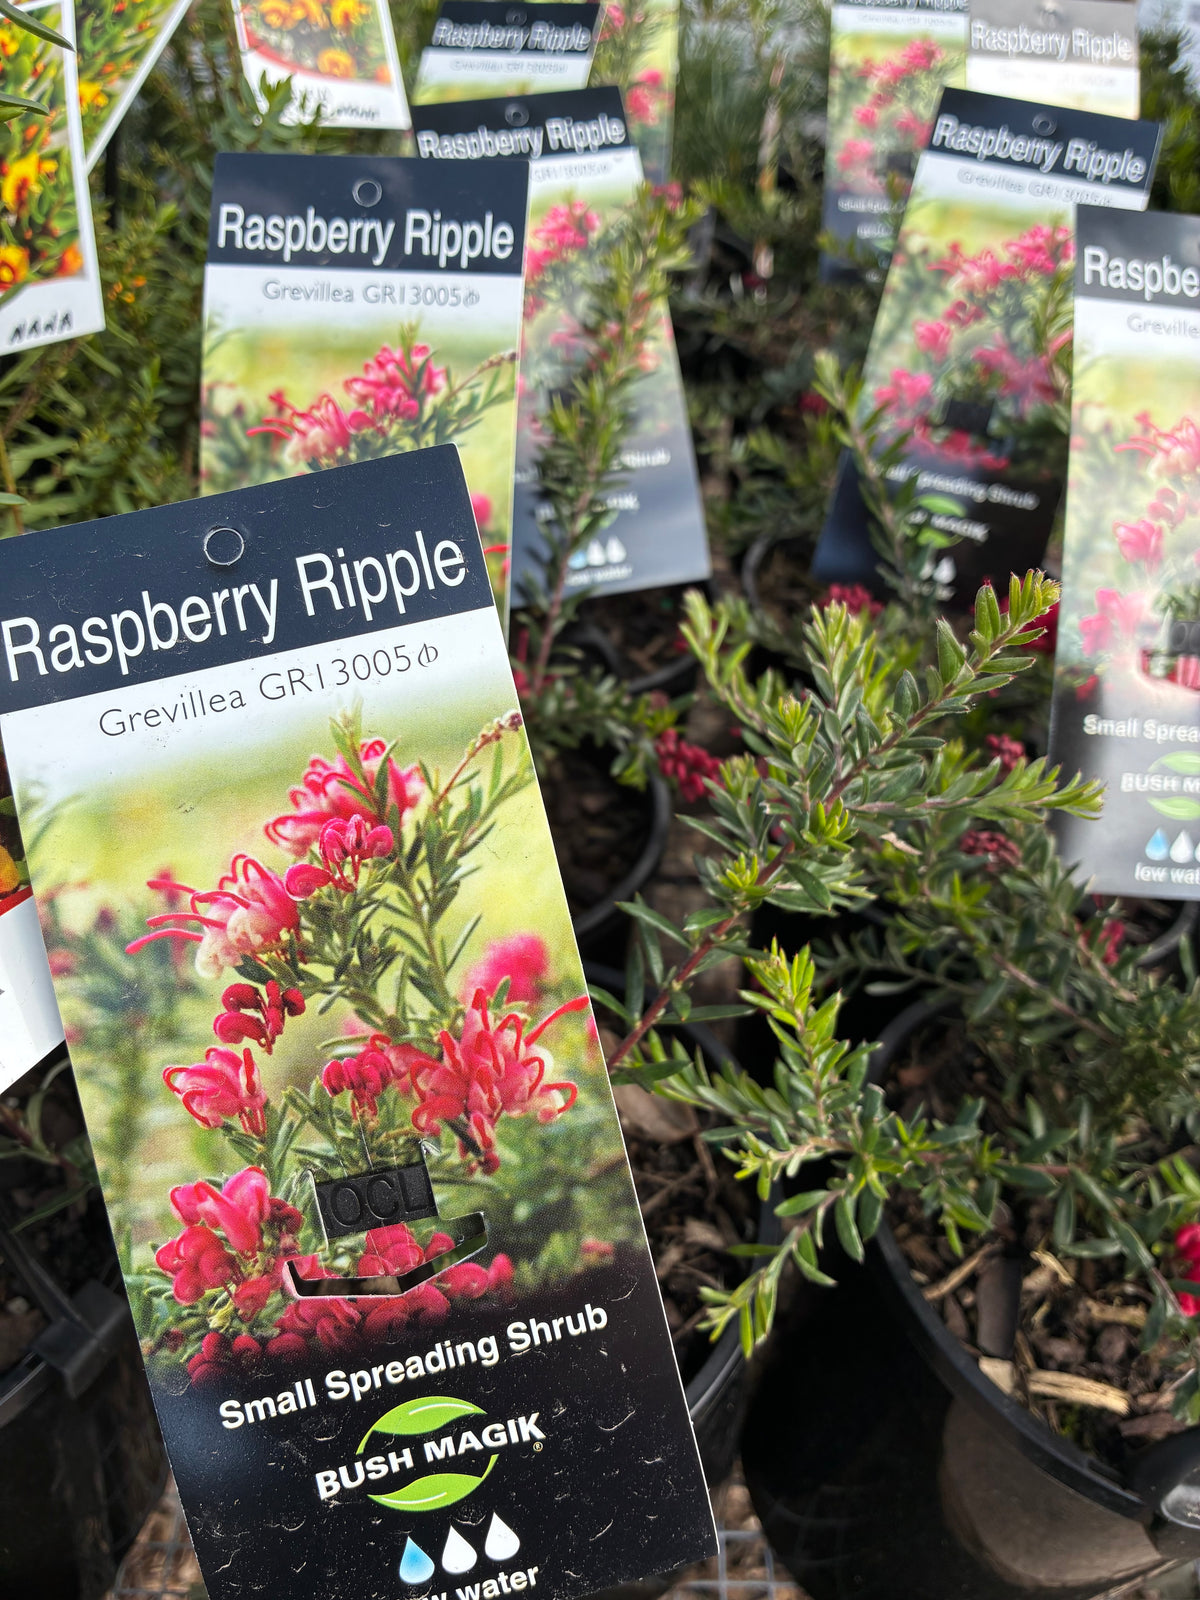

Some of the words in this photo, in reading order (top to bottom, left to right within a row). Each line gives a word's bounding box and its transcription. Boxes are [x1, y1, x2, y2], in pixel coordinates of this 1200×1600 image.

[971, 19, 1069, 62] Raspberry
[1071, 27, 1134, 64] Ripple
[416, 124, 543, 159] Raspberry
[545, 112, 626, 154] Ripple
[932, 113, 1064, 173] Raspberry
[1063, 137, 1148, 183] Ripple
[217, 202, 396, 267] Raspberry
[403, 208, 515, 269] Ripple
[262, 279, 355, 302] Grevillea
[1083, 244, 1200, 302] Raspbe
[1, 578, 279, 682] Raspberry
[295, 530, 467, 622] Ripple
[99, 689, 247, 737] Grevillea
[1083, 713, 1138, 738] Small
[1121, 773, 1180, 793] BUSH
[1134, 861, 1168, 882] low
[317, 1168, 431, 1230] OCL
[219, 1378, 317, 1430] Small
[325, 1333, 499, 1402] Spreading
[505, 1303, 608, 1352] Shrub
[315, 1448, 414, 1500] BUSH
[455, 1565, 539, 1600] water
